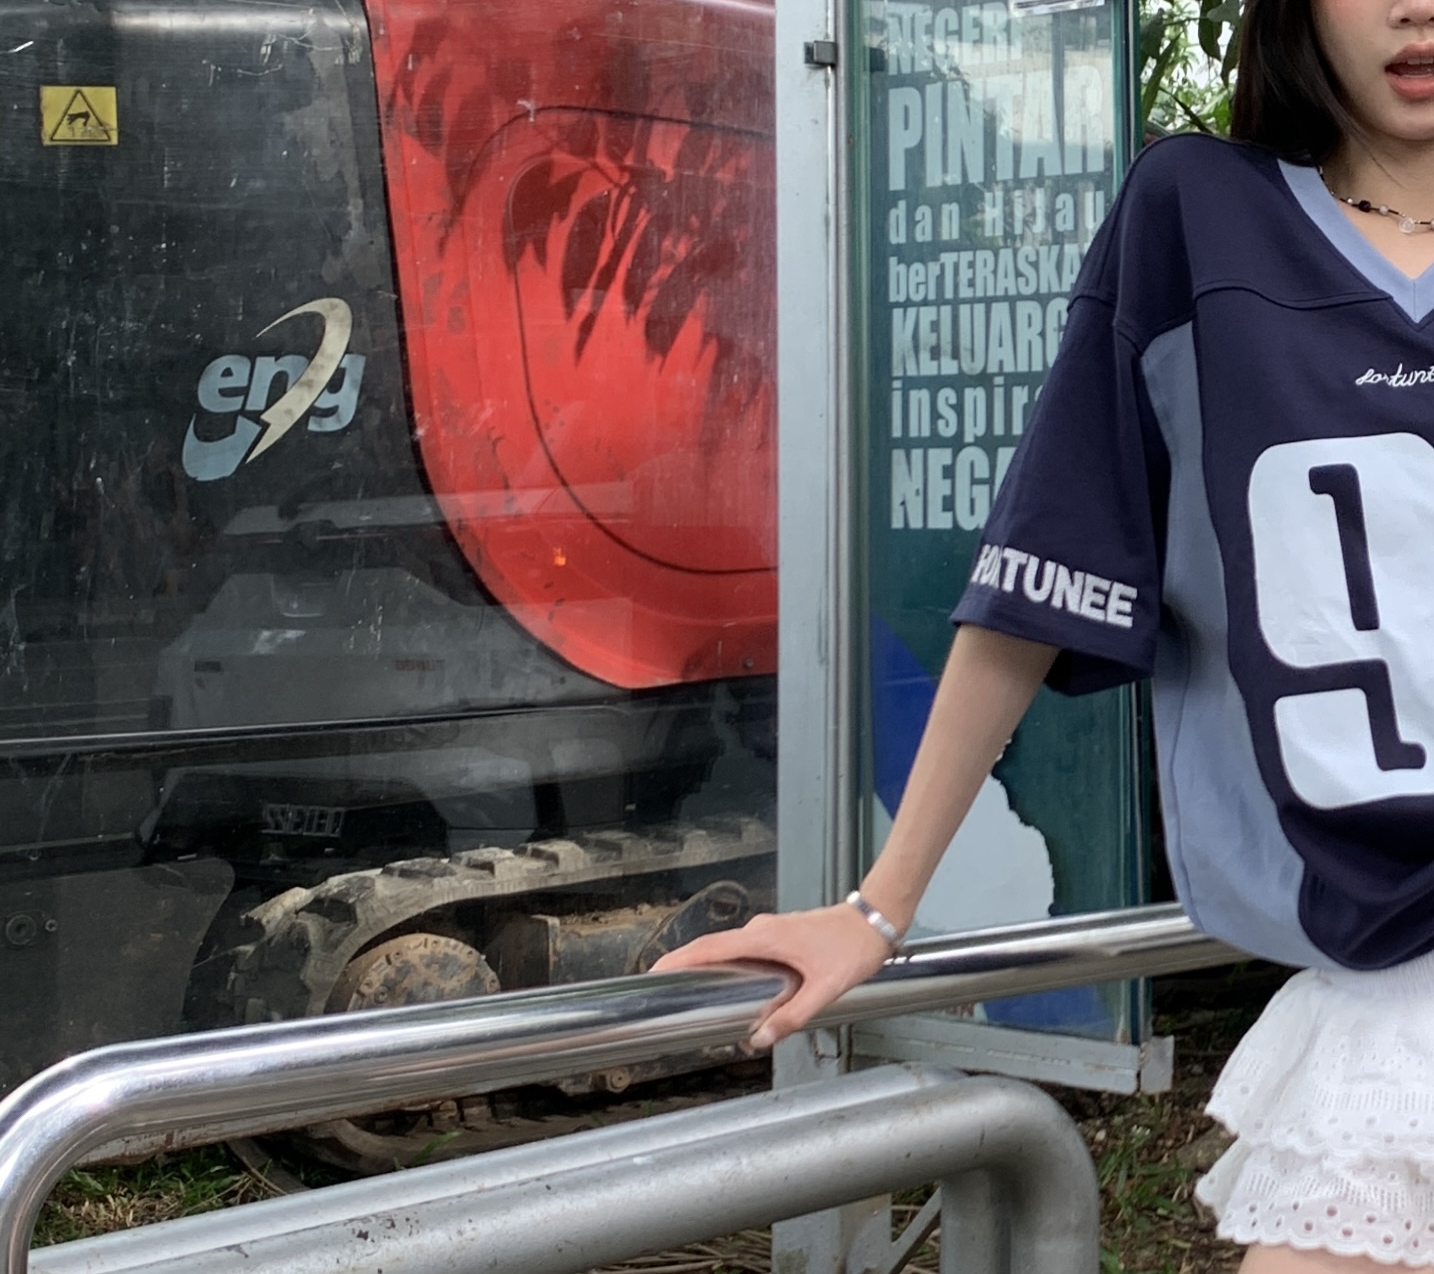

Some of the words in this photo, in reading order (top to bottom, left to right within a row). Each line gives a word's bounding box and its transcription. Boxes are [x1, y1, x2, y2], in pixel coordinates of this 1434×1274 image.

[888, 65, 1105, 191] PINTAR
[889, 199, 961, 245] dan
[888, 242, 1088, 303] berTERASKA
[891, 297, 1070, 377] KELUARG
[891, 376, 1043, 444] inspir
